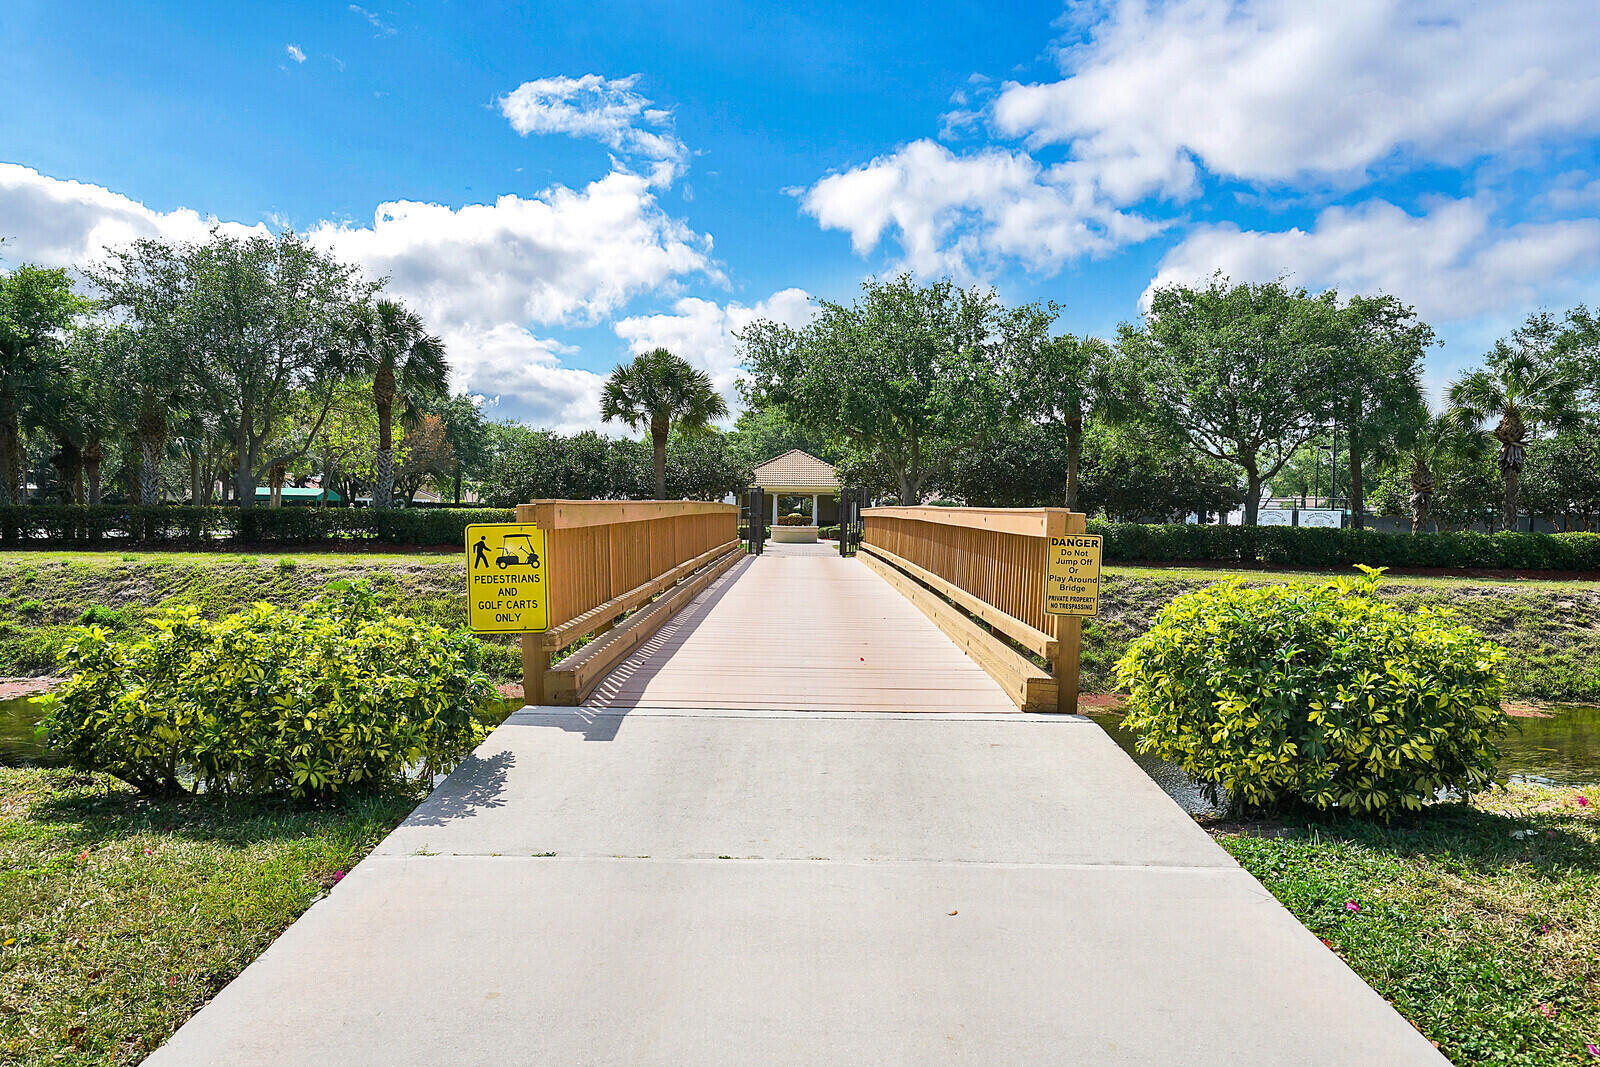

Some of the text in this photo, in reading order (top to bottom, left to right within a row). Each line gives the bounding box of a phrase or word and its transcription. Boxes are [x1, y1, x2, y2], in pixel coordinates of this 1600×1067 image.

[1051, 538, 1099, 548] DANGER
[1056, 558, 1078, 567] Jump
[474, 574, 541, 584] PEDESTRIANS
[1049, 575, 1098, 584] Play Around
[497, 587, 518, 597] AND
[1059, 584, 1086, 593] Bridge
[478, 600, 538, 610] GOLF CARTS
[495, 613, 521, 622] ONLY
